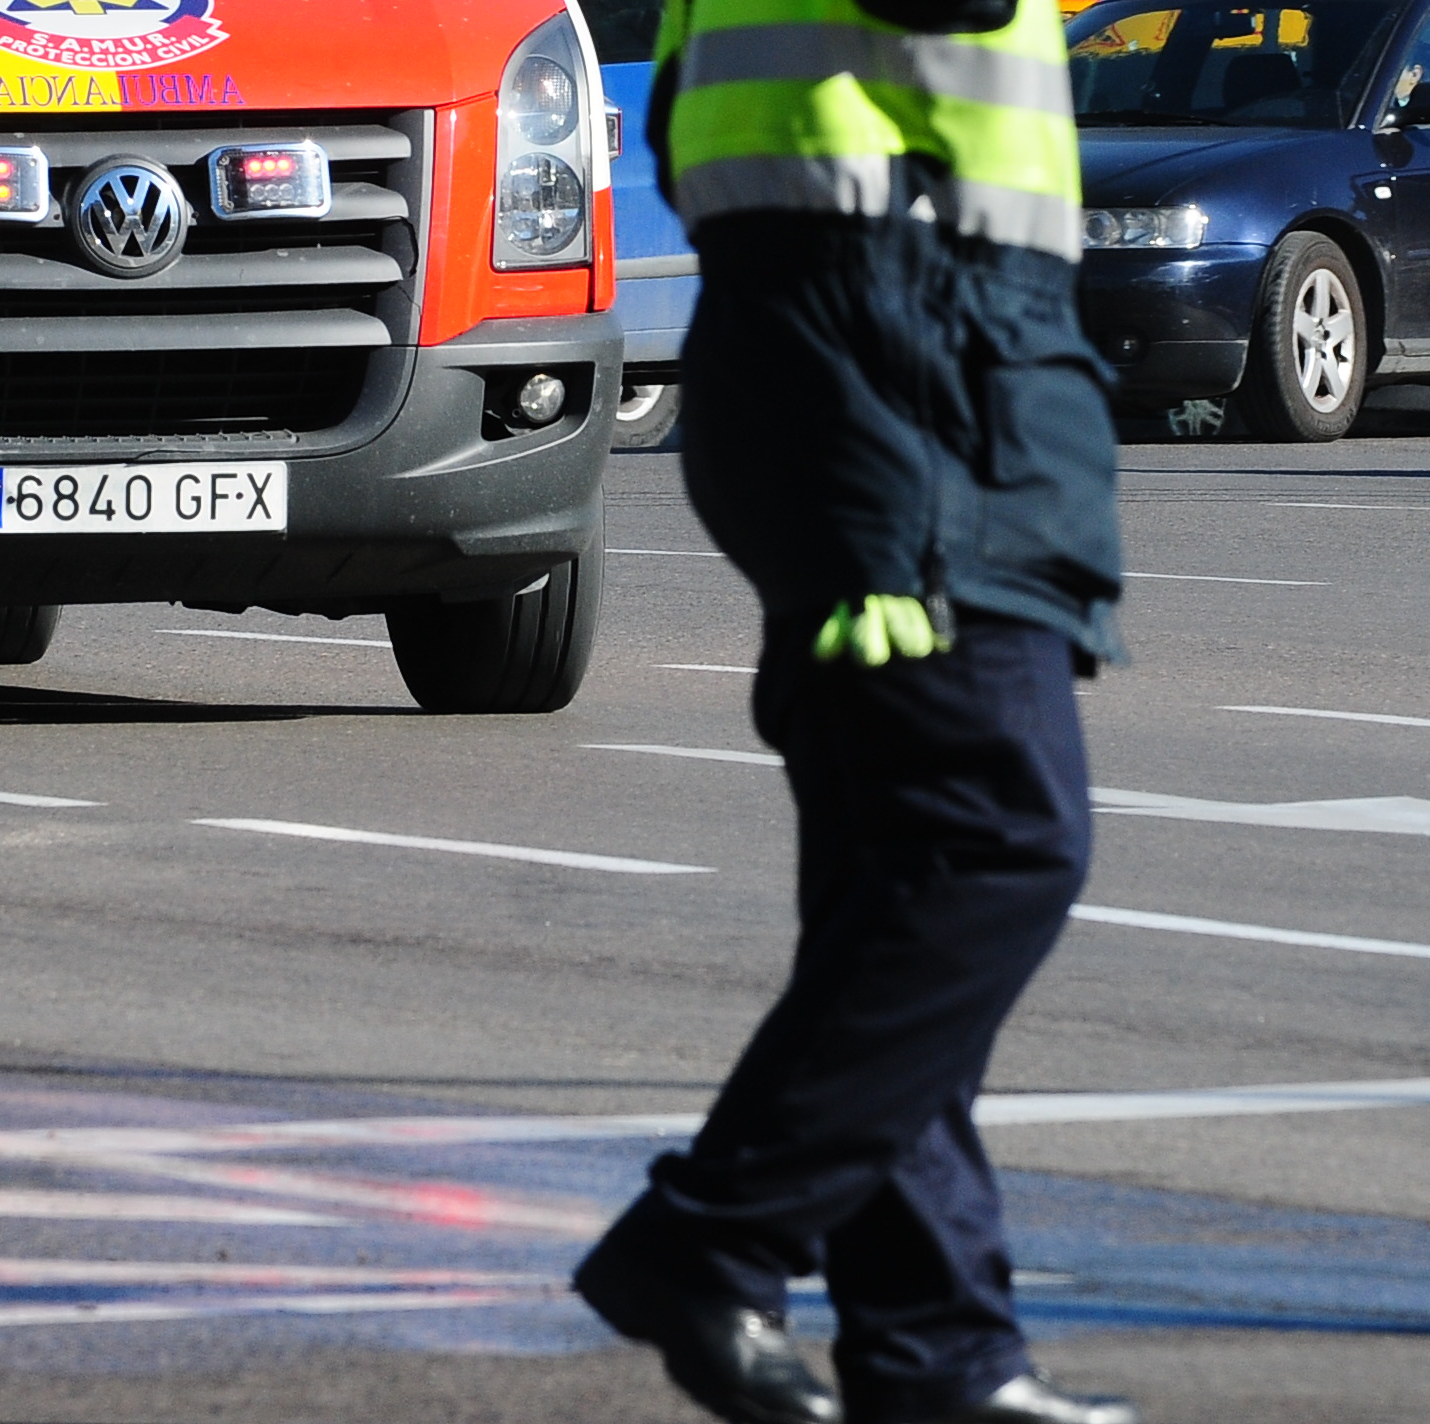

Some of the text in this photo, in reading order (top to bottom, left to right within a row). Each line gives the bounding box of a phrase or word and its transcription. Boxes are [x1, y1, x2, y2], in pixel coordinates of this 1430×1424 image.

[30, 31, 178, 53] S.A.M.U.R.
[158, 33, 210, 60] CIVIL
[16, 472, 273, 521] 6840 GFX
